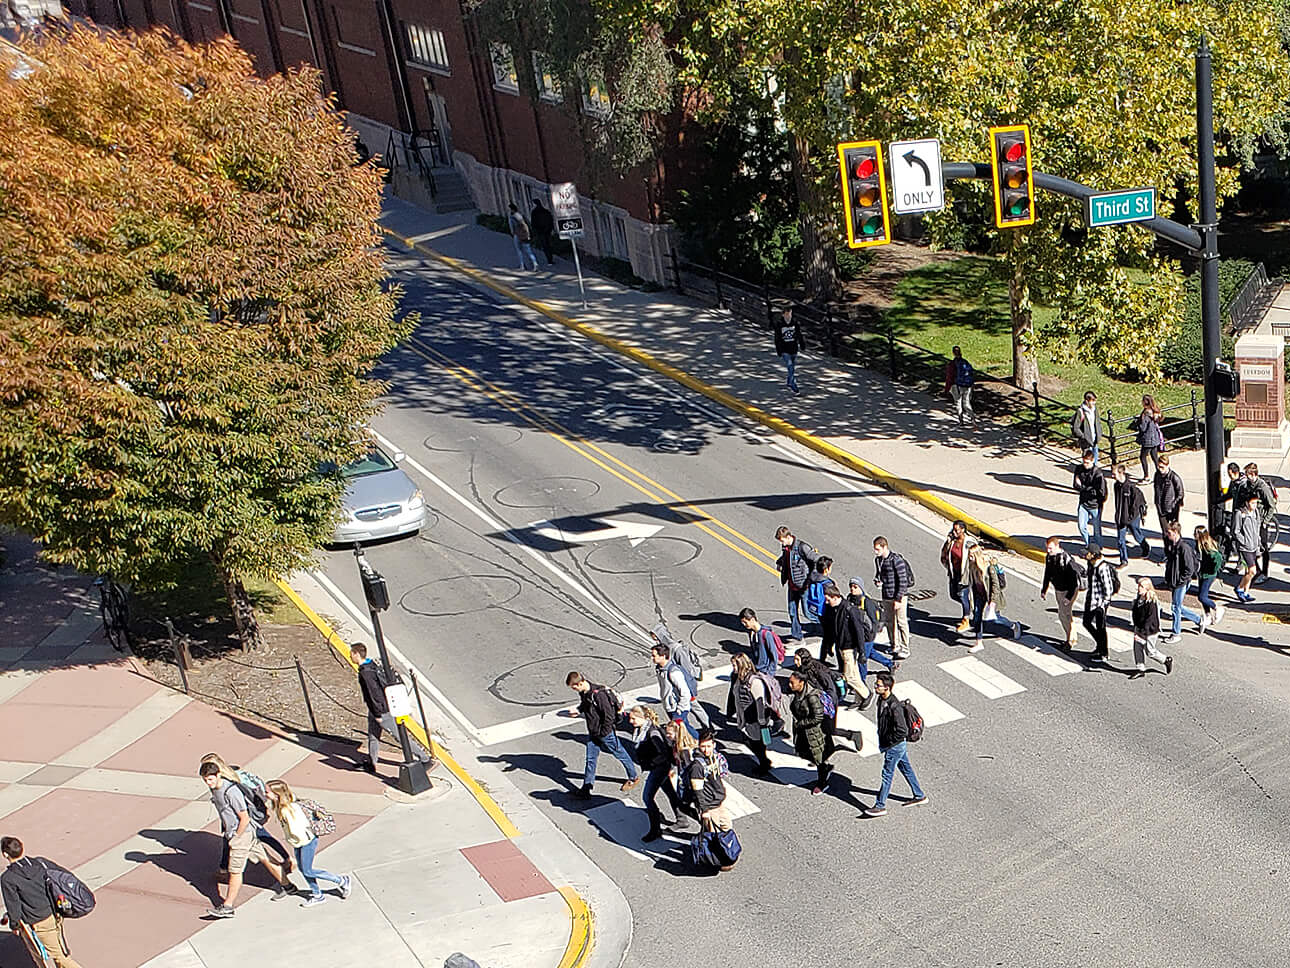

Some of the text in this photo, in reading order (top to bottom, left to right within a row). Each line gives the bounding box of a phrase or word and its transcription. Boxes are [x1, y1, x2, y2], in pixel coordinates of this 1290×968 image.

[903, 190, 934, 206] ONLY
[1095, 196, 1149, 219] Third St
